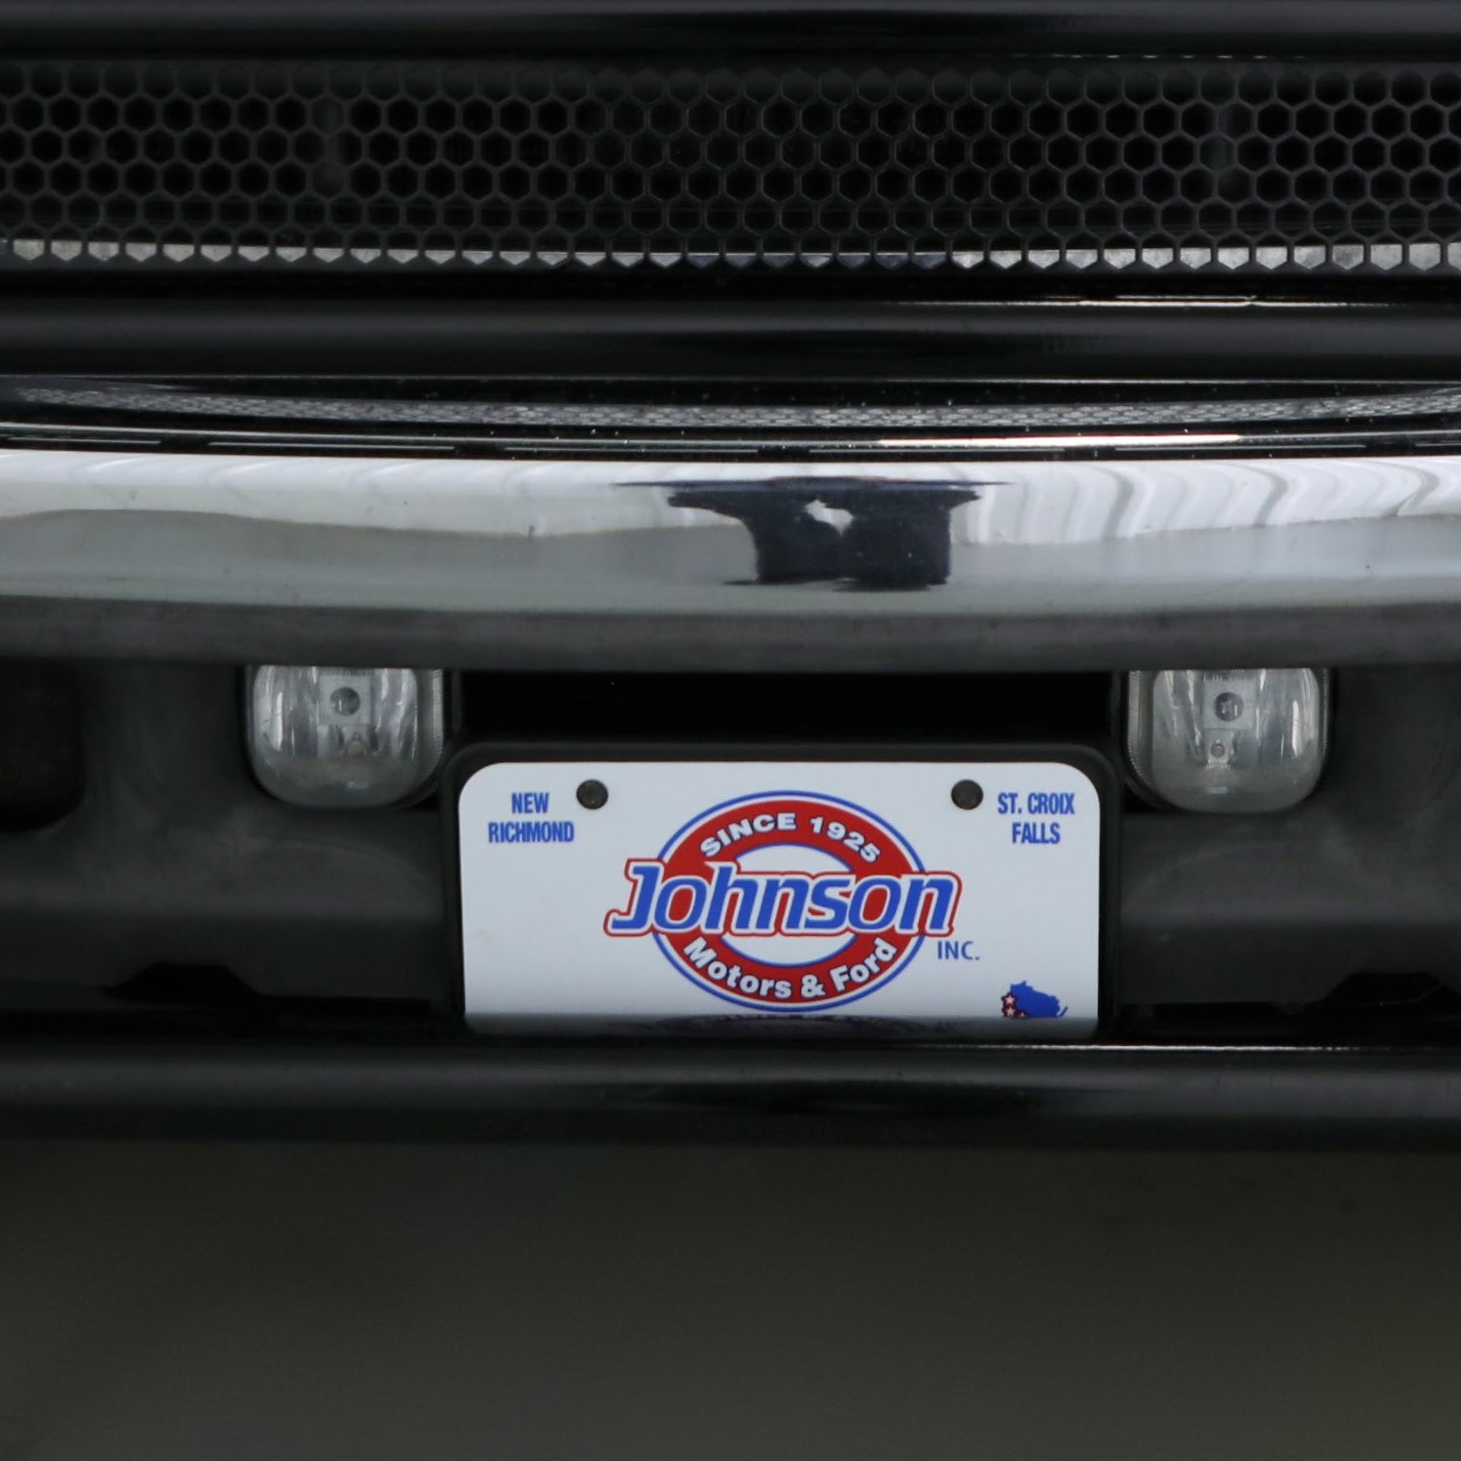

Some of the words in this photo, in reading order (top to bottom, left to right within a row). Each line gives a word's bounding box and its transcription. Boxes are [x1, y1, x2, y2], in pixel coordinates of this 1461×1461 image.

[511, 791, 550, 814] NEW
[997, 791, 1022, 815] ST.
[1027, 791, 1075, 815] CROIX
[488, 820, 575, 843] RICHMOND
[699, 812, 797, 858] SINCE
[810, 816, 881, 863] 1925
[1011, 821, 1062, 844] FALLS
[607, 862, 959, 934] Johnson
[937, 940, 981, 961] INC.
[683, 936, 792, 999] Motors
[800, 974, 826, 998] &
[829, 937, 898, 991] Ford
